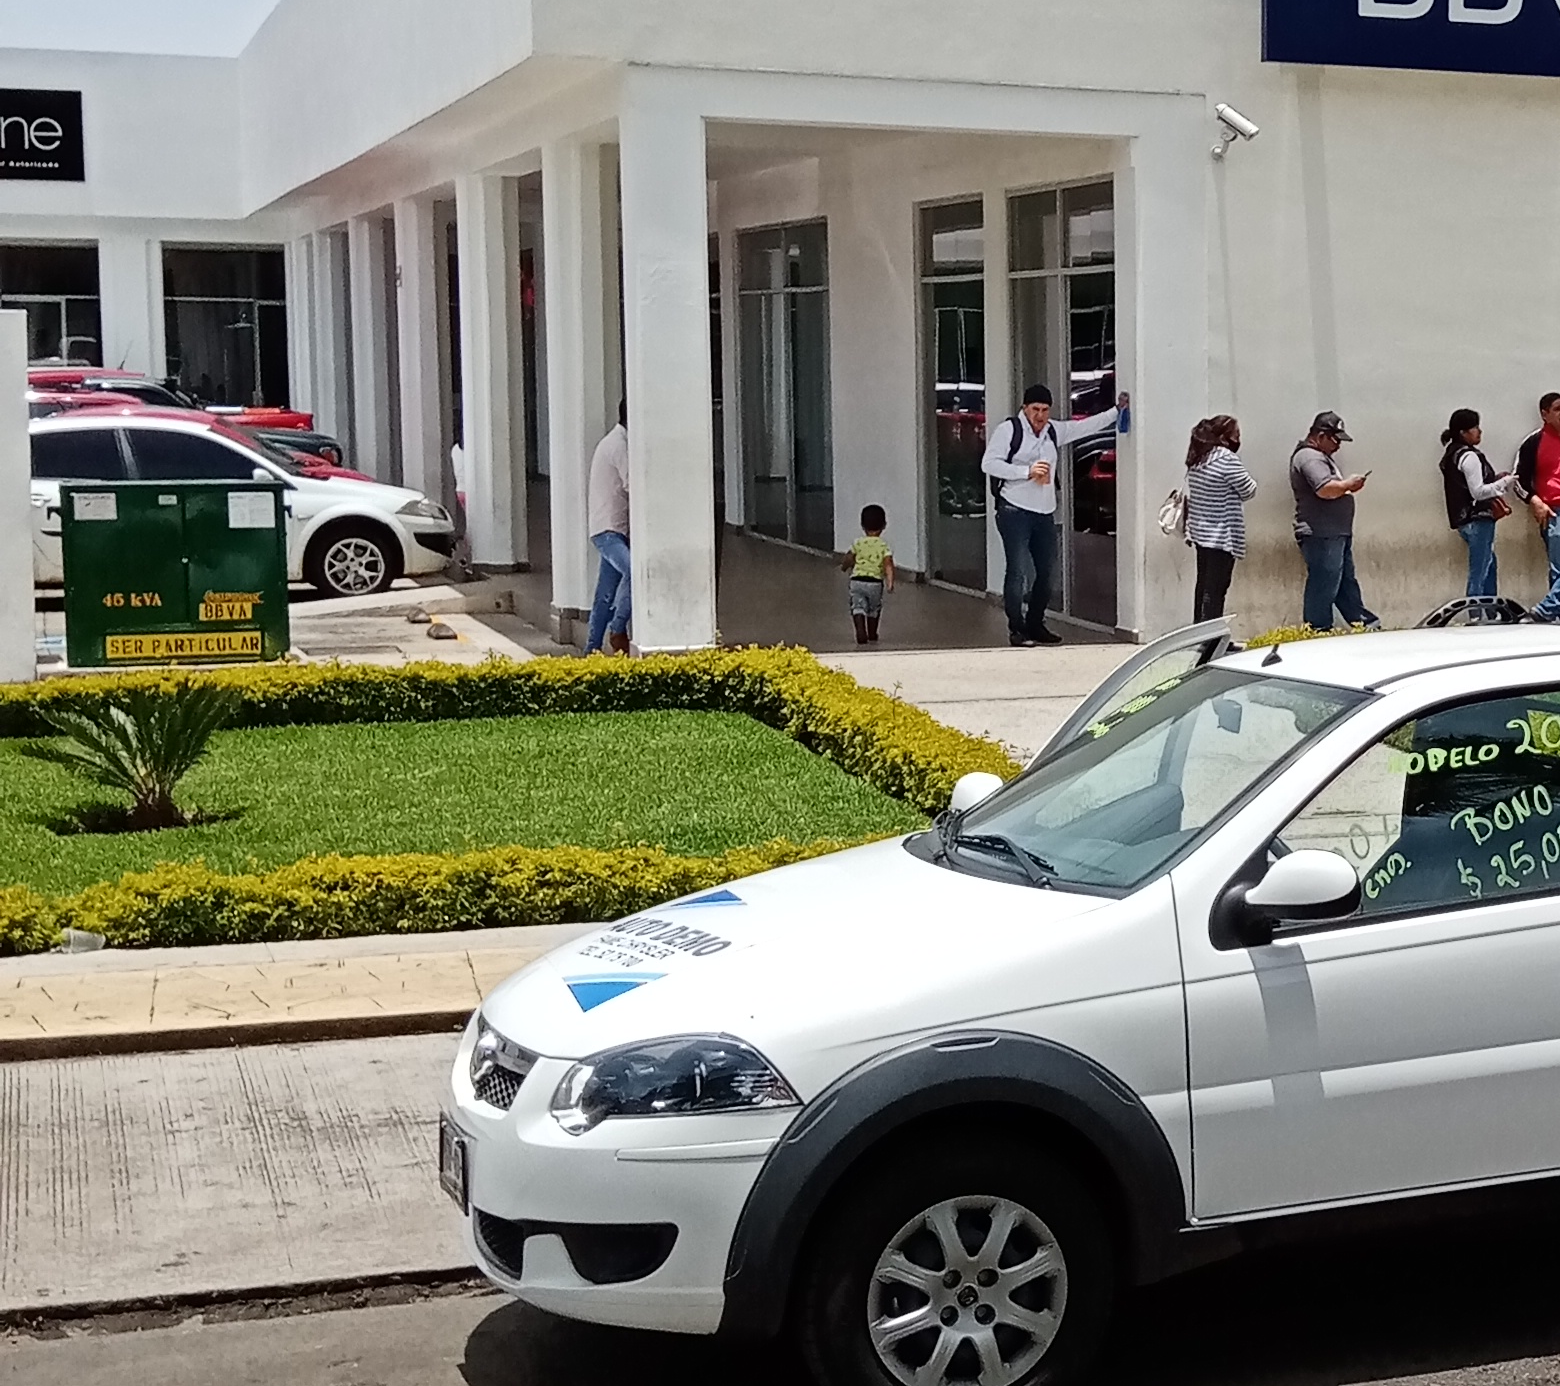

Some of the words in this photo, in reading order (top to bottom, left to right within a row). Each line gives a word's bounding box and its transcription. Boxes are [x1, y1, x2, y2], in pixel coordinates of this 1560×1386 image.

[130, 592, 162, 607] kVA
[204, 603, 247, 619] BBVA
[110, 639, 144, 655] SER
[152, 636, 260, 655] PARTICULAR
[1450, 785, 1554, 846] BONO
[649, 924, 732, 957] DEMO
